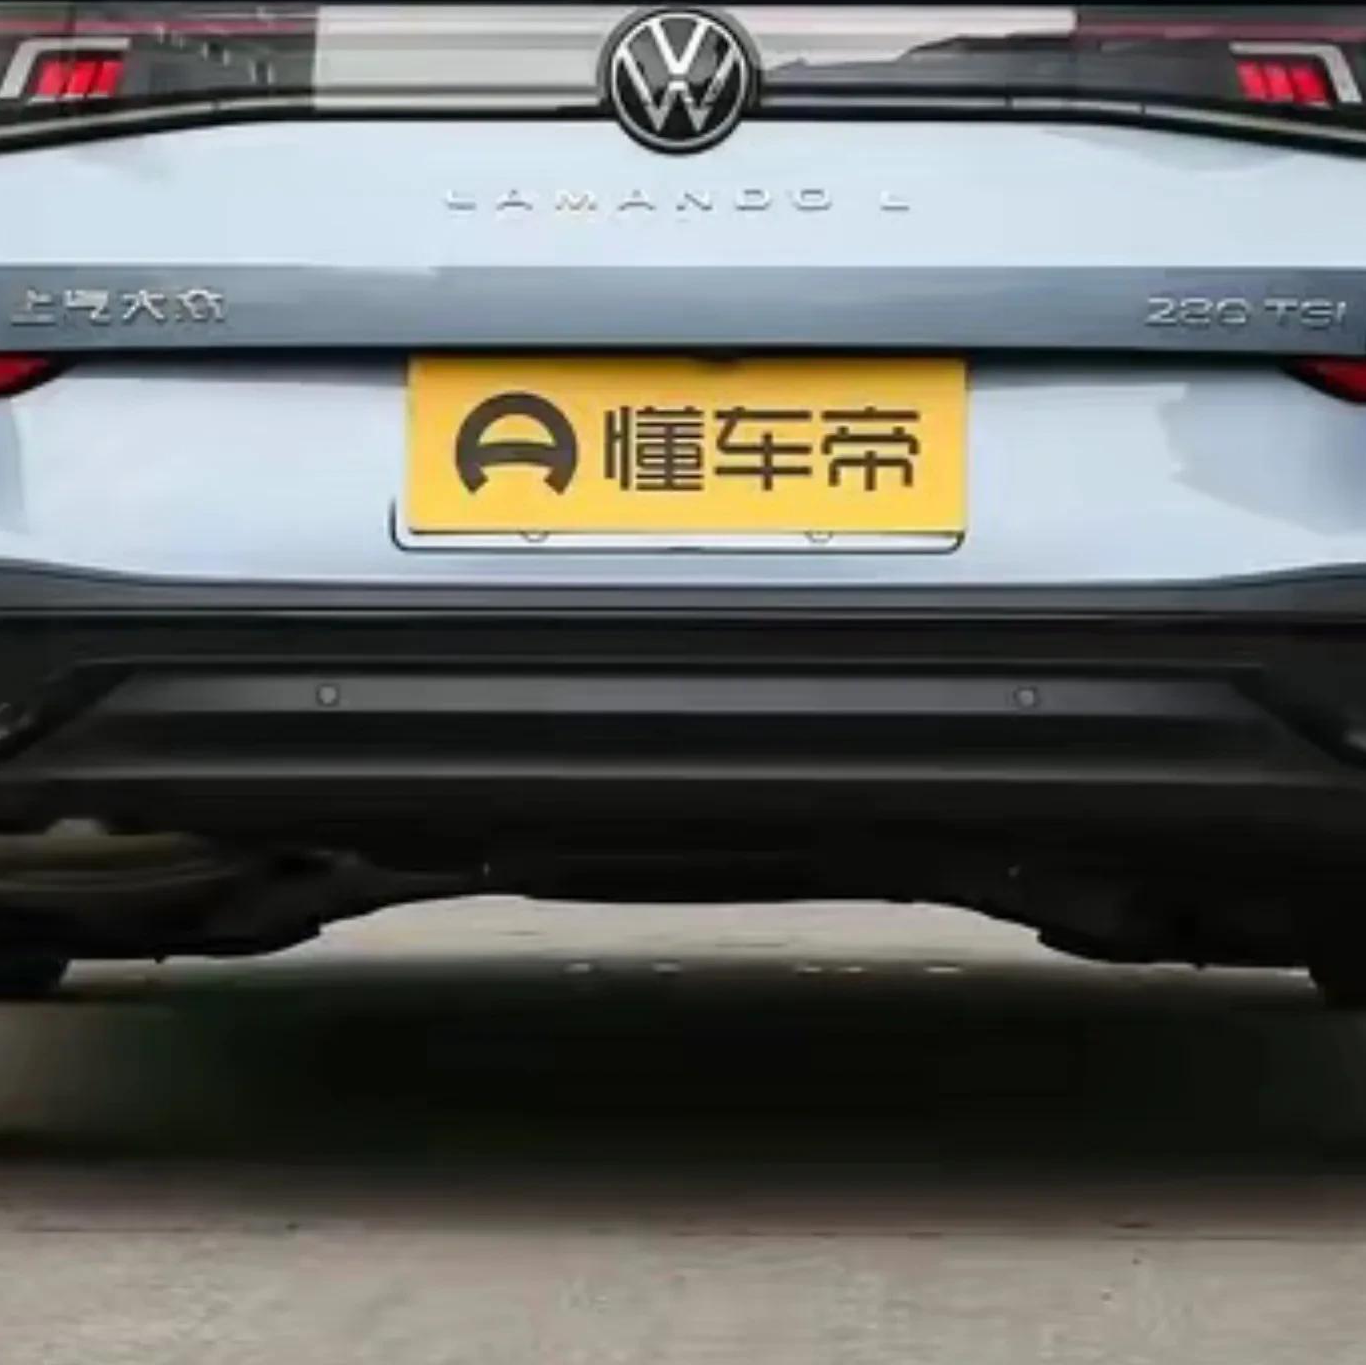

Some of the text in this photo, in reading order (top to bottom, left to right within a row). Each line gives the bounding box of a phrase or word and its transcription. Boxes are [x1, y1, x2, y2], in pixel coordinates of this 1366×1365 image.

[443, 187, 913, 212] LAMANDO L
[11, 287, 227, 326] 上汽大众
[1264, 297, 1348, 330] TSI
[603, 405, 921, 492] 懂车帝
